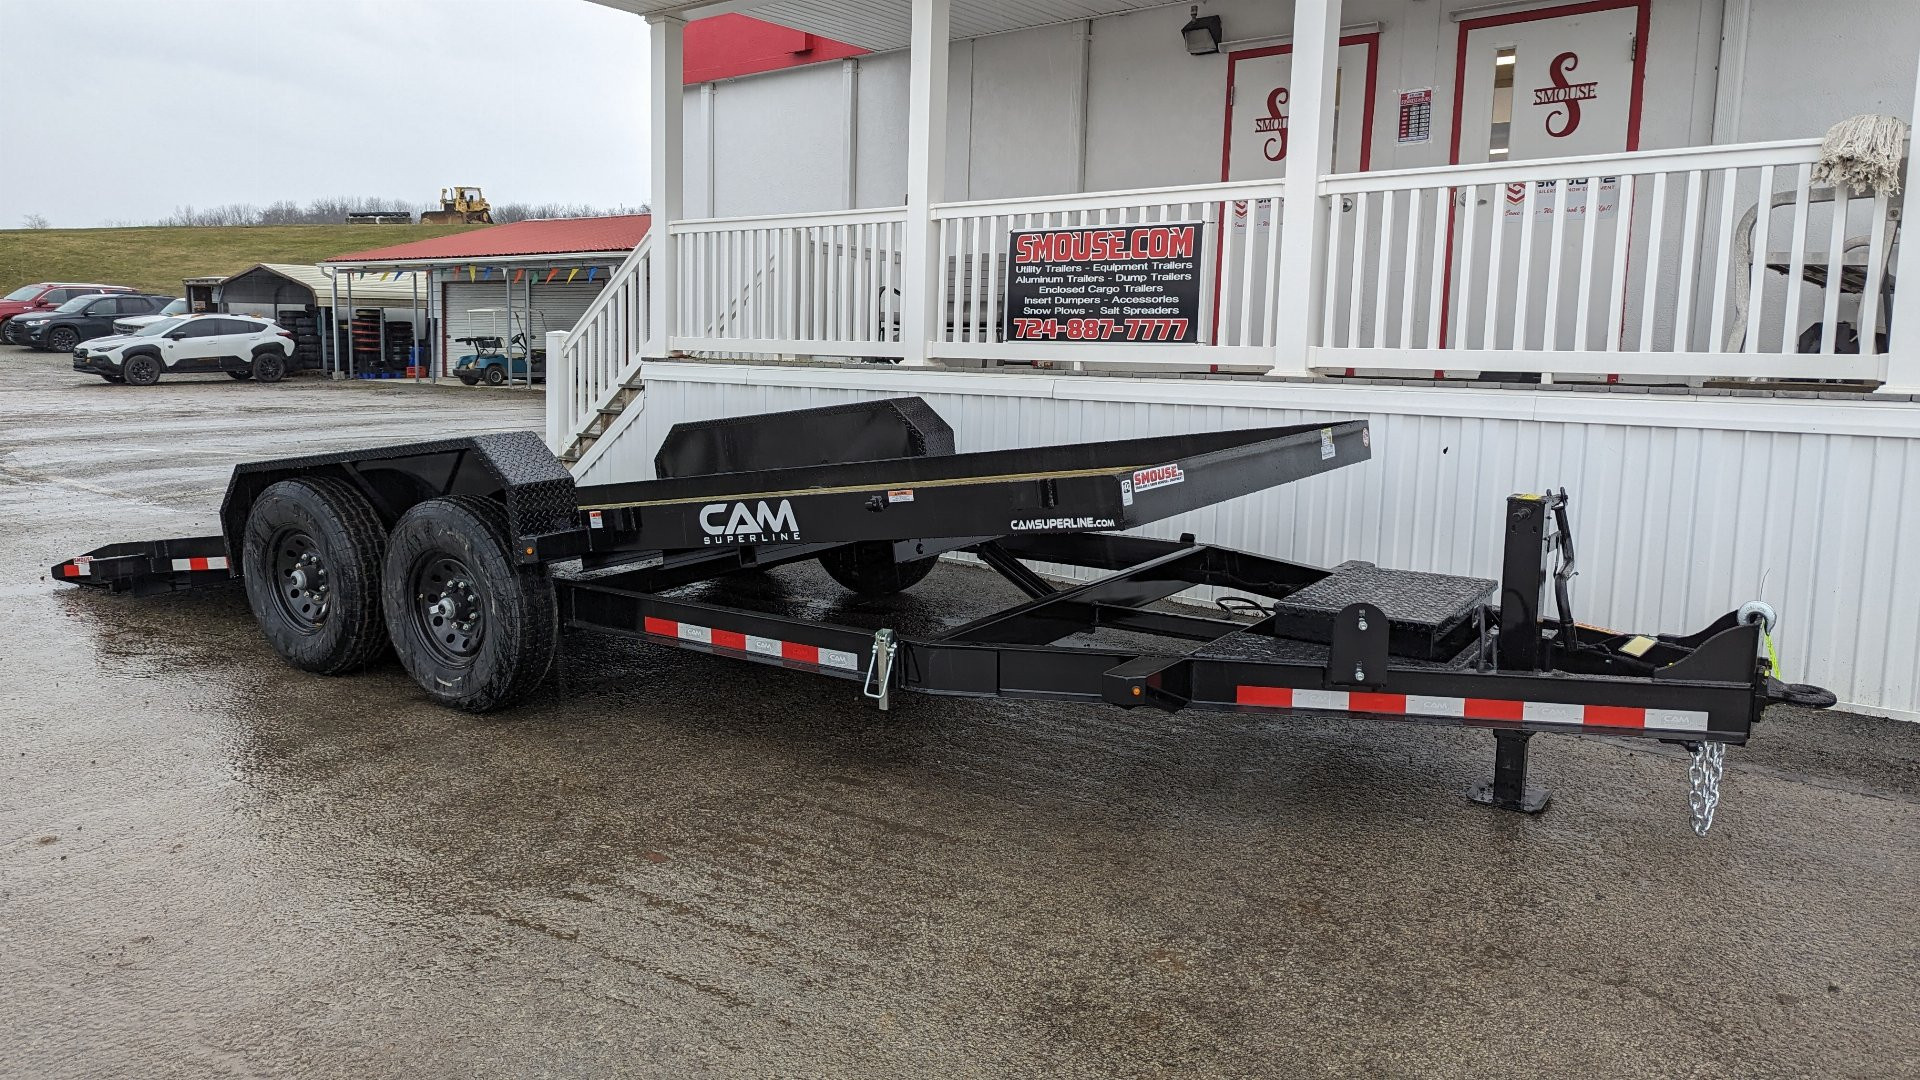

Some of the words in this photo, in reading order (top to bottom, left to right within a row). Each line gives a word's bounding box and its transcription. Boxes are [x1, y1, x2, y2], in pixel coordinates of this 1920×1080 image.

[1534, 83, 1597, 105] SMOUSE
[1256, 118, 1288, 131] SMOU
[1016, 226, 1195, 263] SMOUSE.COM
[1016, 265, 1042, 274] Utility
[1045, 264, 1082, 273] Trailers
[1093, 262, 1148, 272] Equipment
[1152, 261, 1193, 270] Trailers
[1016, 275, 1063, 284] Aluminum
[1067, 274, 1104, 283] Trailers
[1116, 273, 1147, 282] Dump
[1151, 272, 1192, 281] Trailers
[1039, 285, 1085, 294] Enclosed
[1088, 285, 1120, 294] Cargo
[1123, 284, 1164, 293] Trailers
[1024, 296, 1052, 304] Insert
[1055, 296, 1101, 305] Dumpers
[1112, 295, 1180, 304] Accessories
[1023, 306, 1052, 315] Snow
[1055, 306, 1086, 315] Plows
[1100, 306, 1120, 315] Salt
[1123, 306, 1180, 316] Spreaders
[1013, 317, 1189, 340] 724-887-7777
[699, 499, 799, 536] CAM
[1010, 516, 1116, 531] CAMSUPERLINE.COM
[703, 531, 800, 545] SUPERLINE
[687, 628, 702, 636] CAM
[756, 641, 772, 649] CAM
[829, 654, 846, 662] CAM
